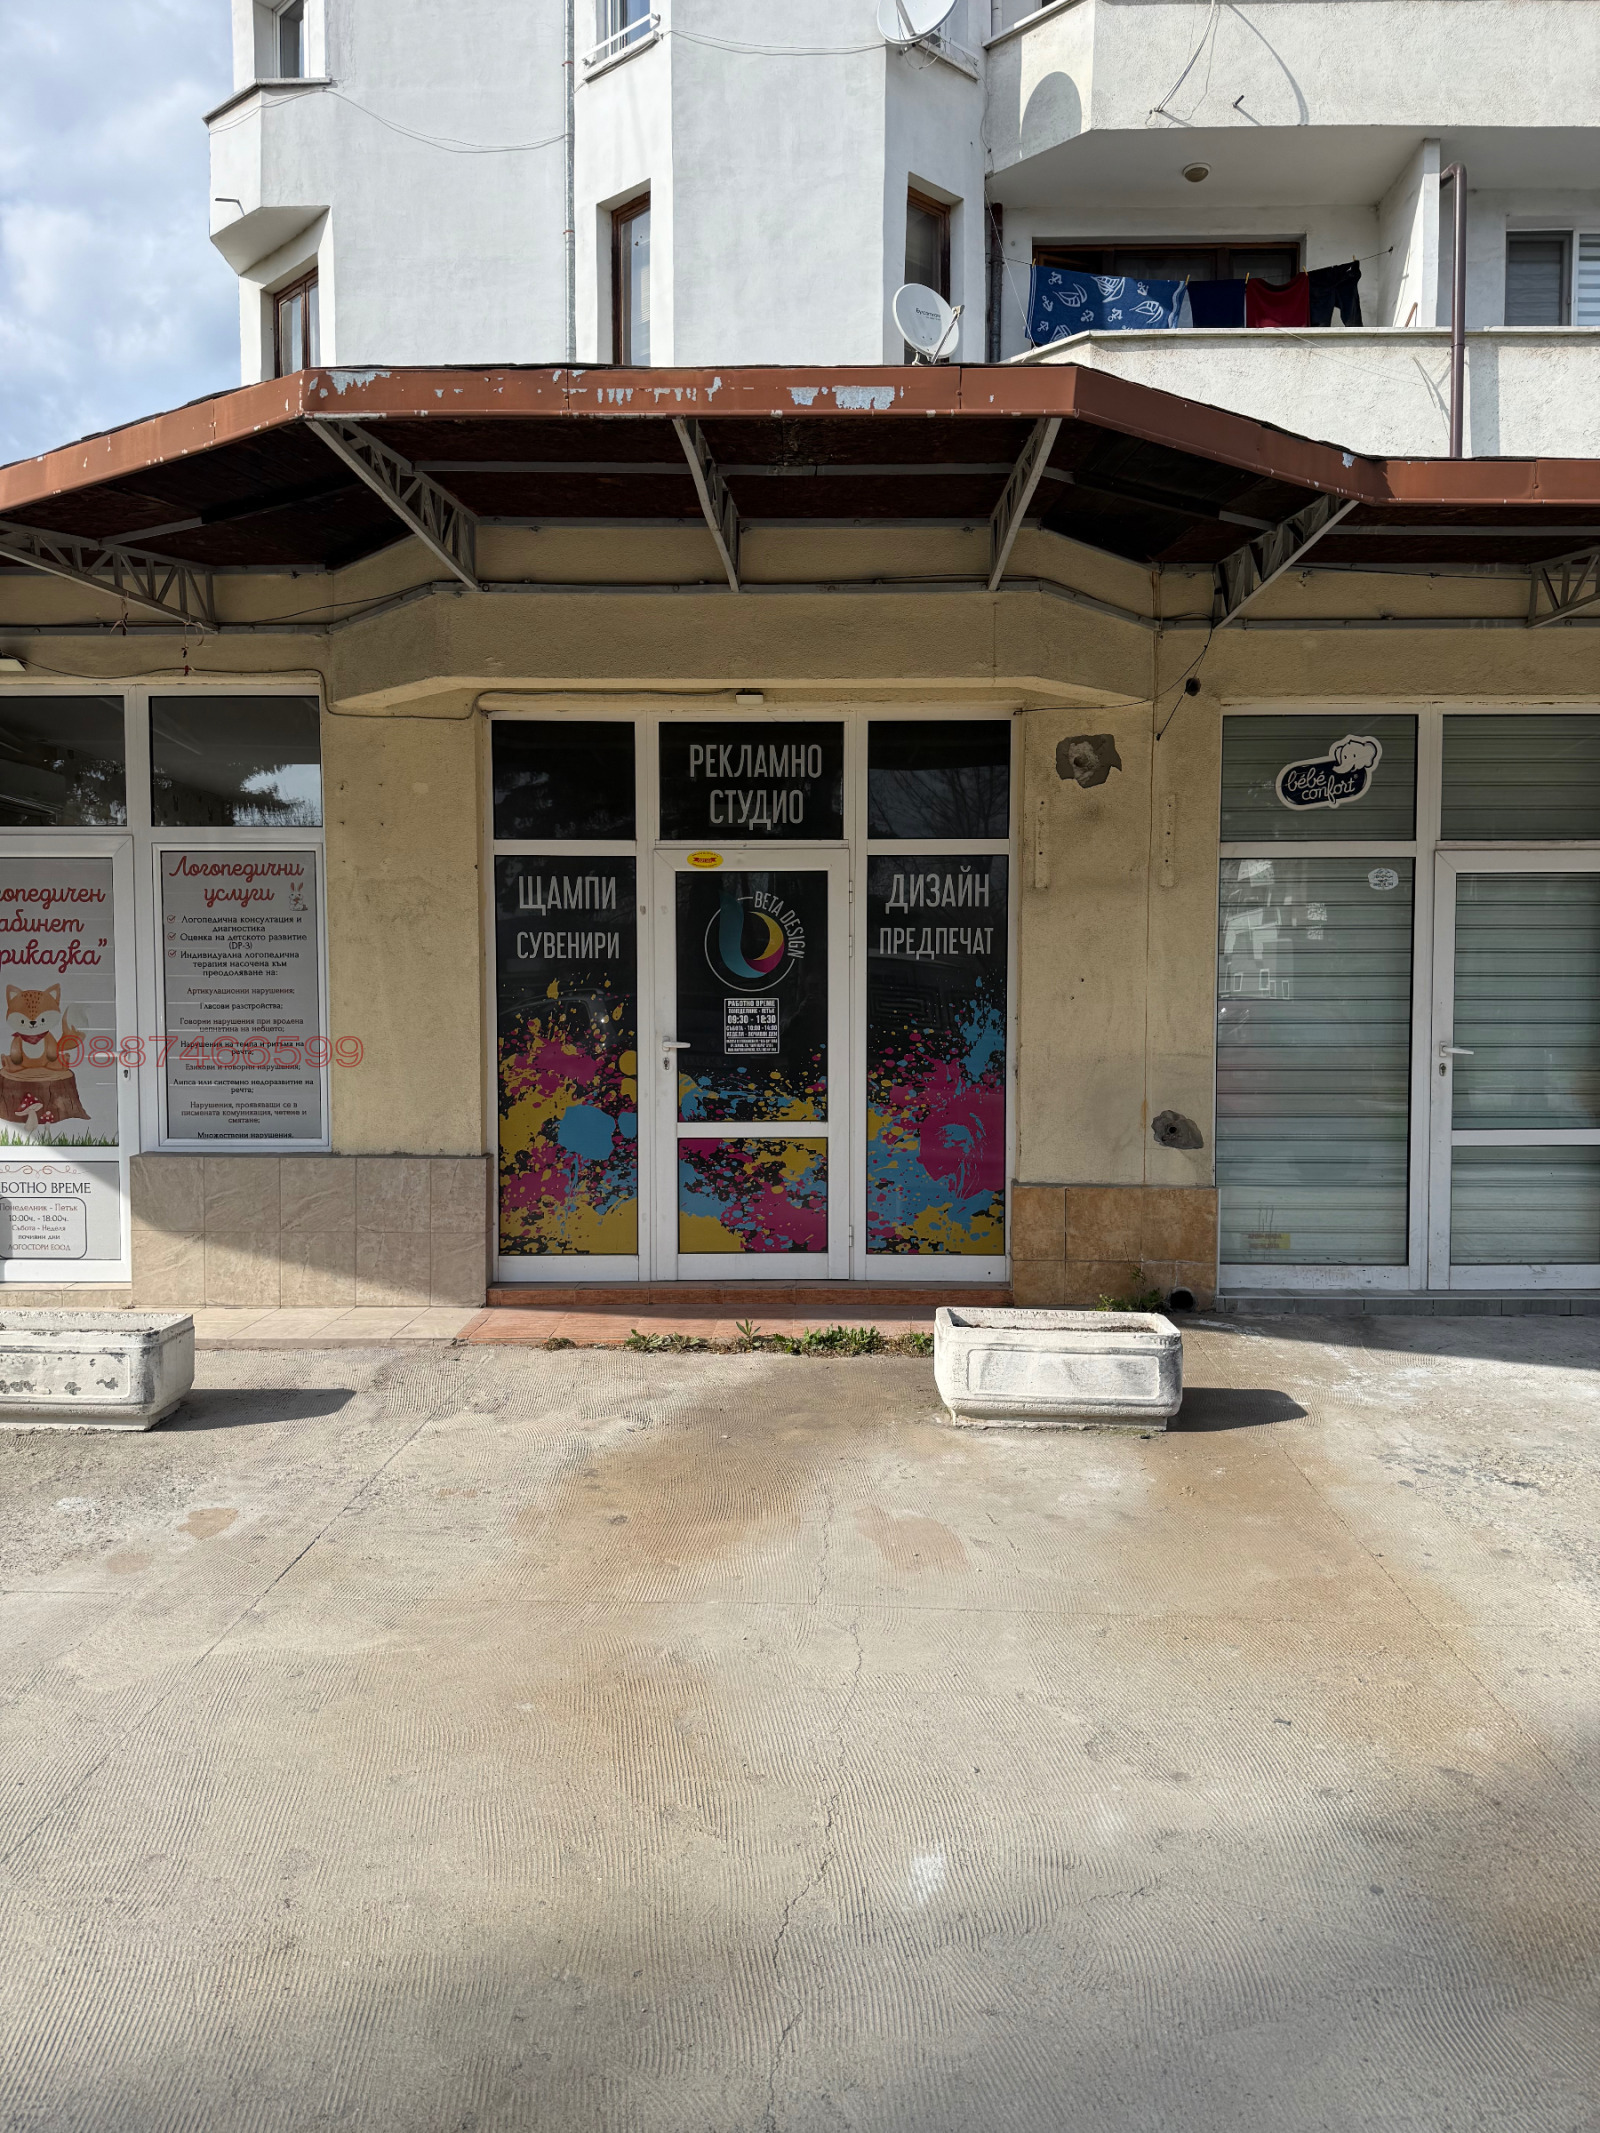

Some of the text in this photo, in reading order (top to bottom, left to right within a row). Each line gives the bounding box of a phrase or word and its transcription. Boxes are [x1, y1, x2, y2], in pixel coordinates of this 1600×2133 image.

[689, 744, 822, 778] РЕКЛАМНО
[1287, 767, 1327, 792] bébé
[710, 789, 804, 830] СТУДИО
[169, 856, 304, 883] Логопедични
[885, 865, 989, 914] ДИЗАЙН
[0, 887, 106, 910] опедичен
[204, 888, 275, 908] услуги
[519, 876, 616, 916] ЩАМПИ
[181, 916, 237, 924] Логопедична
[240, 917, 294, 925] консултация
[754, 891, 806, 958] BETA DESIGN
[180, 933, 212, 941] Оценка
[268, 934, 307, 942] развитие
[880, 927, 994, 960] ПРЕДПЕЧАТ
[228, 942, 253, 950] (DP-3)
[517, 931, 619, 959] СУВЕНИРИ
[180, 951, 300, 960] Индивидуална логопедична
[193, 961, 227, 969] терапия
[203, 970, 264, 978] преодоляване
[187, 987, 249, 995] Артикулационни
[180, 1018, 211, 1026] Говорни
[213, 1018, 255, 1026] нарушения
[257, 1018, 271, 1026] при
[727, 1015, 749, 1024] 09:30
[251, 1079, 303, 1087] недоразвитие
[0, 1182, 91, 1194] БОТНО ВРЕМЕ
[55, 1203, 78, 1212] Петък
